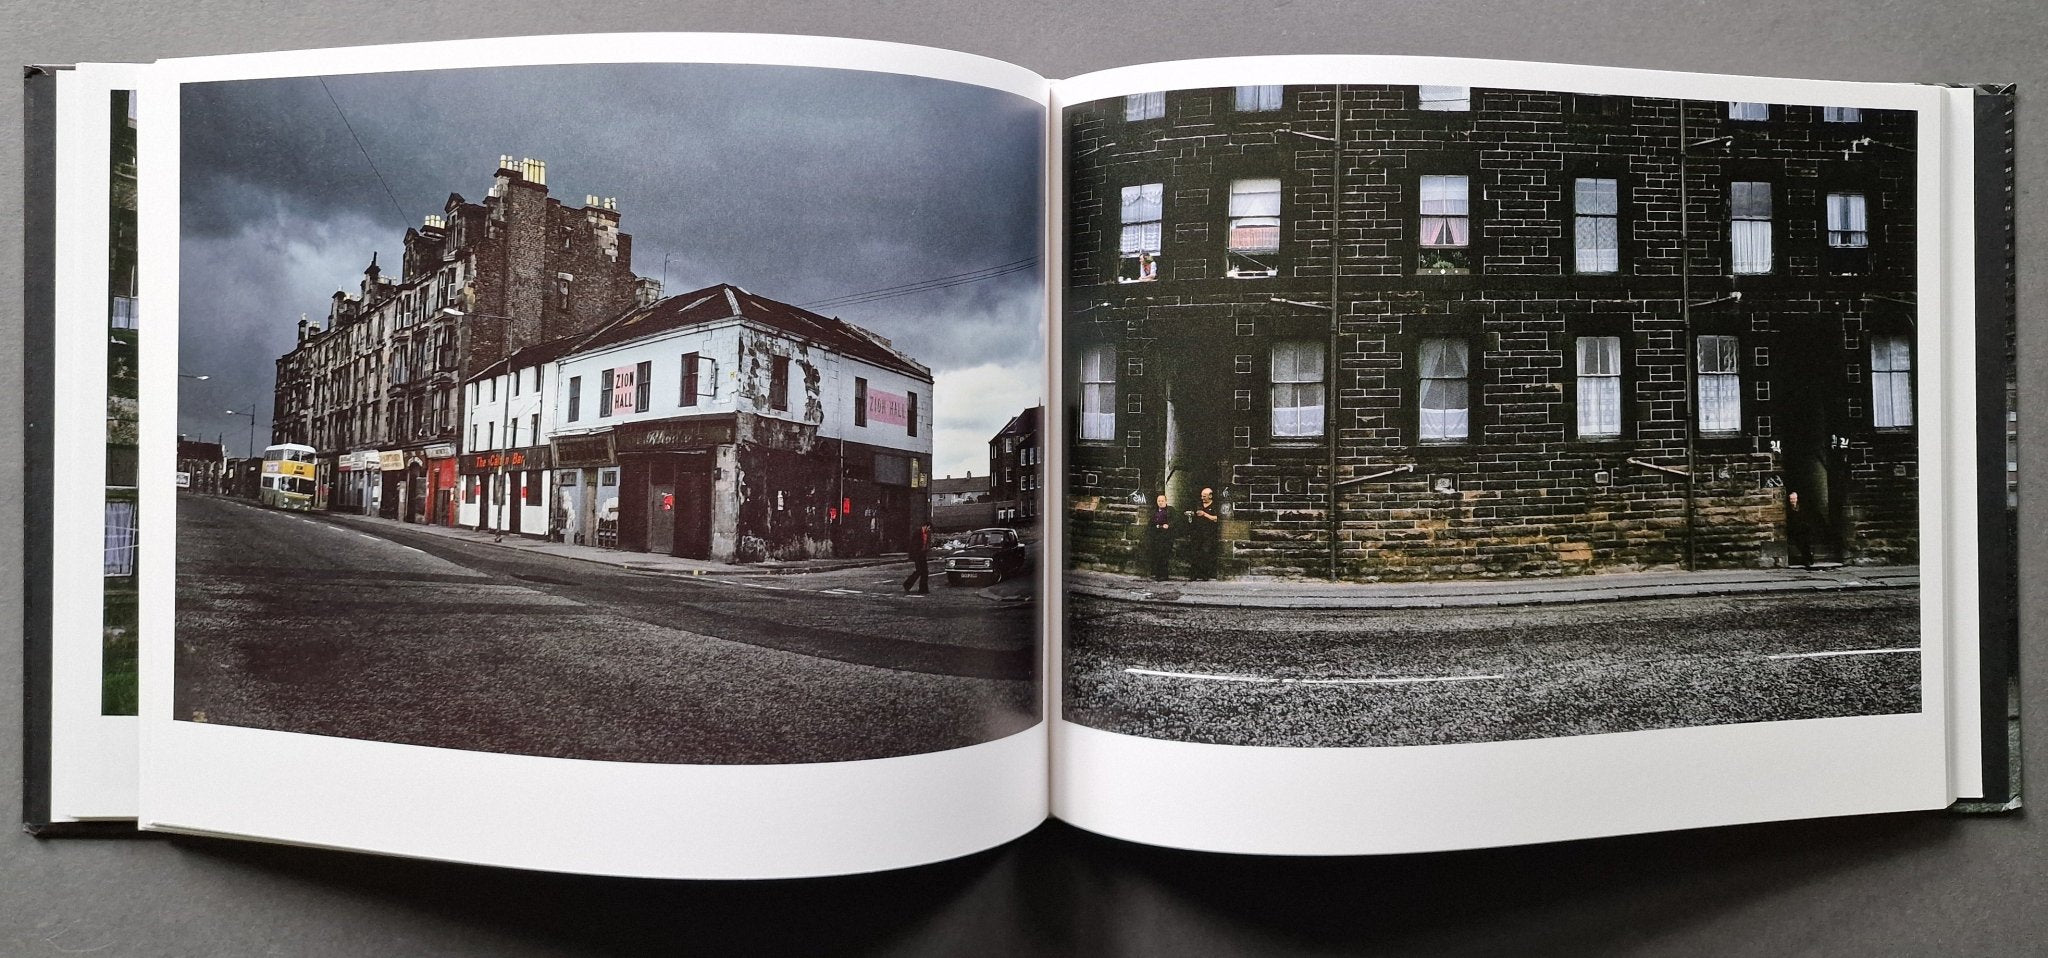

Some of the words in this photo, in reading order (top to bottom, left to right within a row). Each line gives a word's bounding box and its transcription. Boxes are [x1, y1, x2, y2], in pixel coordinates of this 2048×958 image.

[615, 371, 634, 389] ZION
[614, 392, 633, 409] HALL
[869, 396, 886, 414] ZION
[889, 401, 906, 419] HALL
[476, 456, 487, 468] The
[512, 452, 525, 465] Bar
